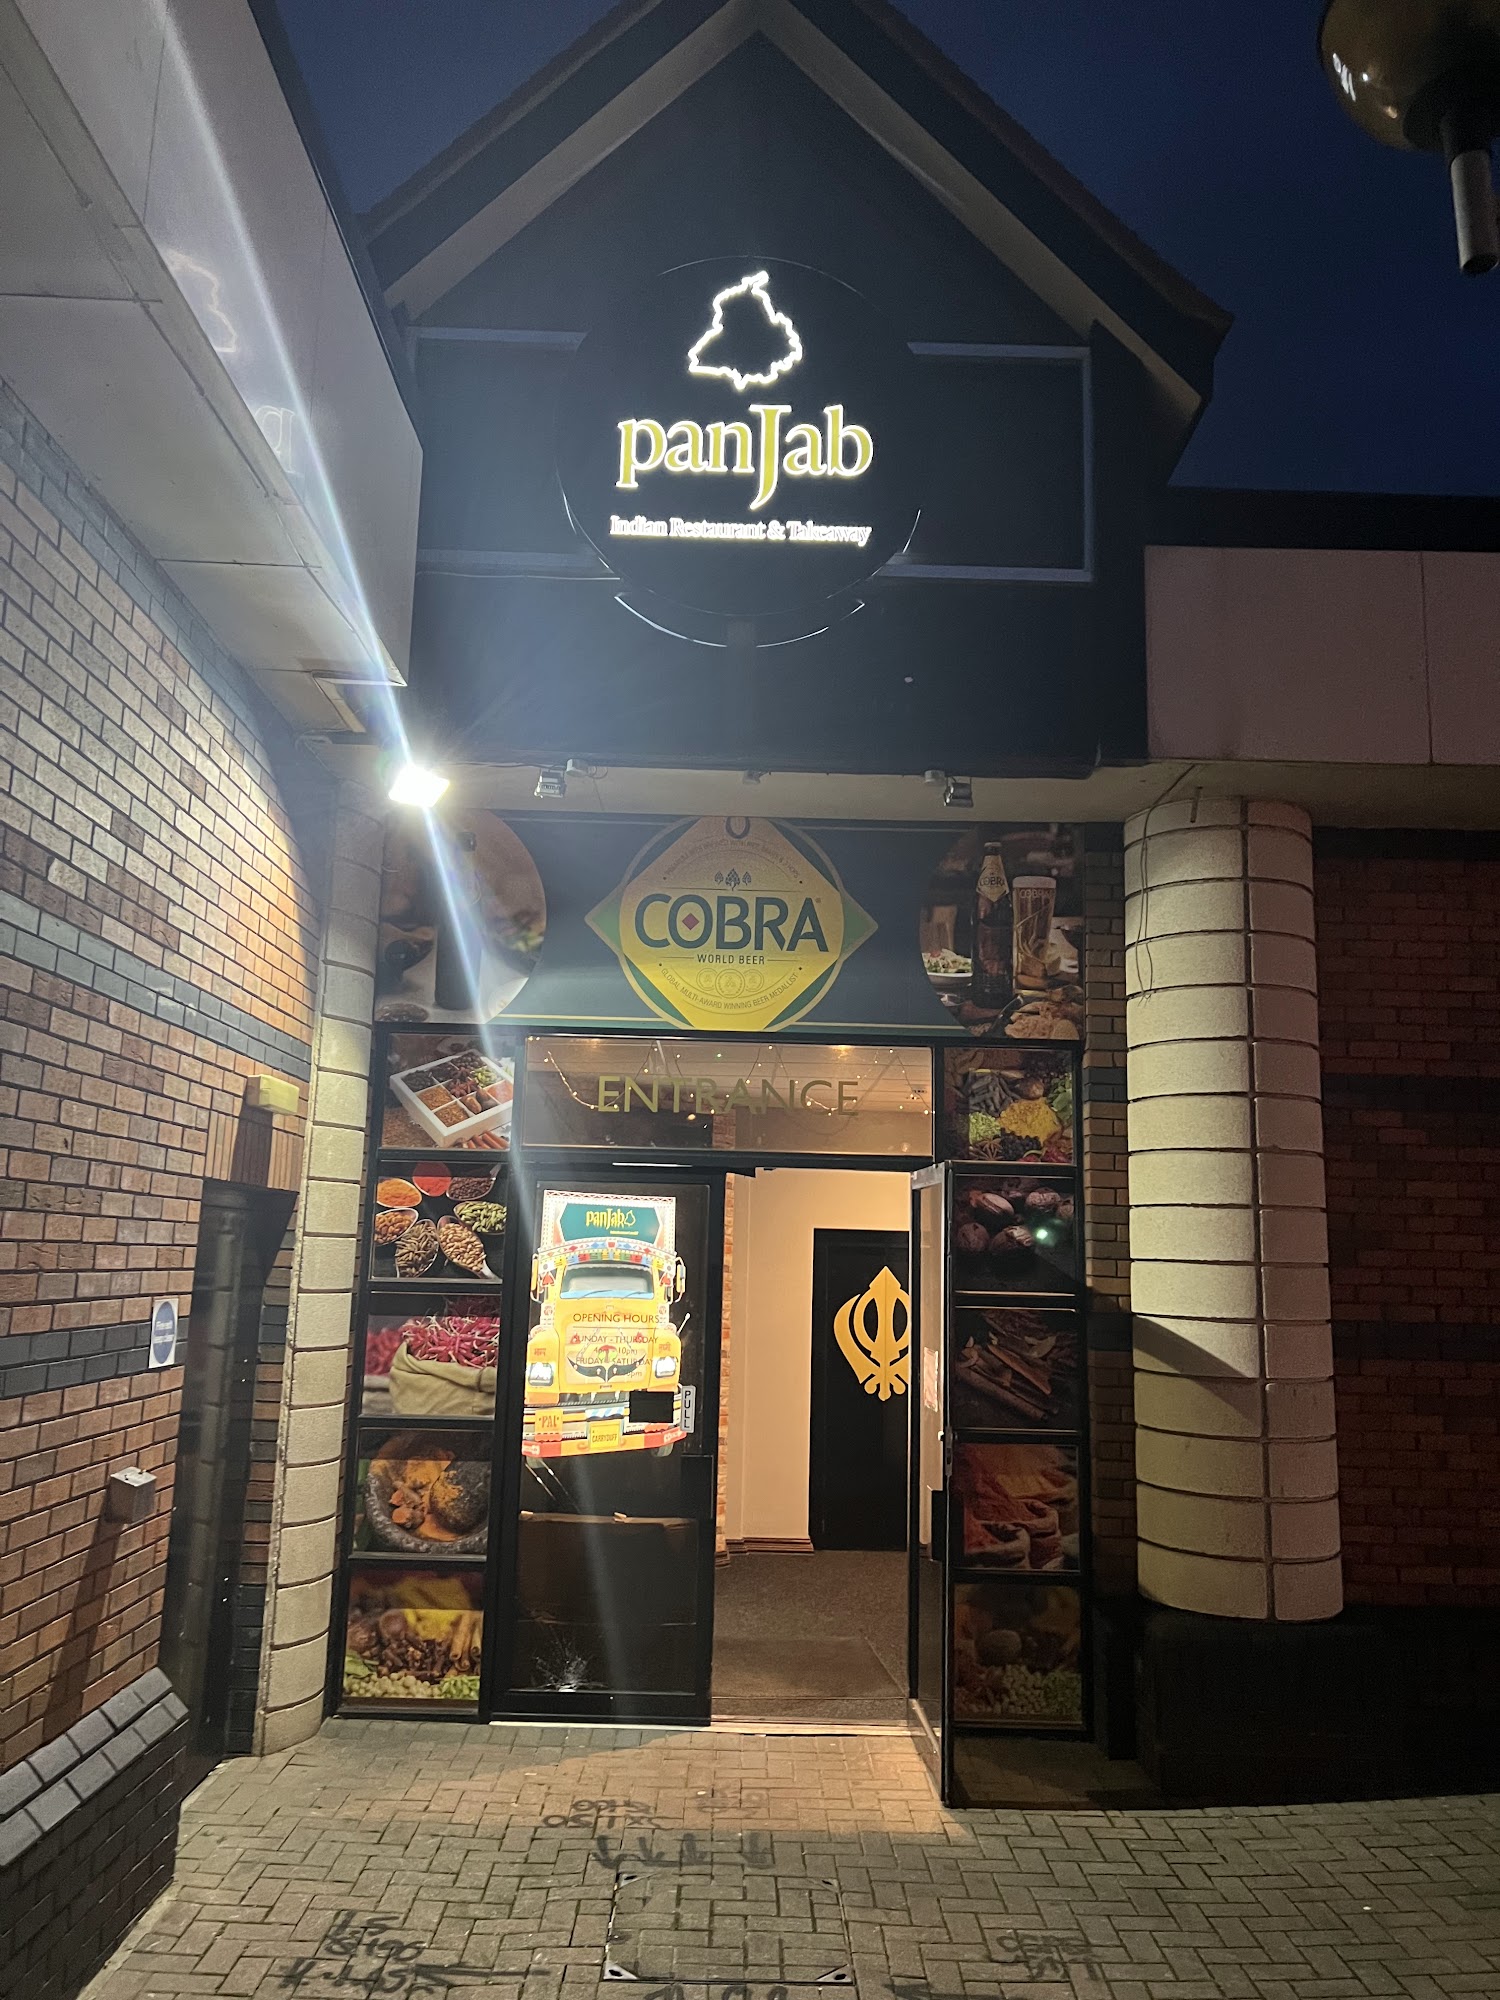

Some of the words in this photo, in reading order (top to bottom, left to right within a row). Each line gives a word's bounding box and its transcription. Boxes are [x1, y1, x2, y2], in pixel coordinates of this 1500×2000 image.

[616, 404, 874, 509] panJab
[610, 515, 667, 536] Indian
[669, 517, 766, 539] Restaurant
[767, 520, 785, 540] &
[786, 521, 872, 547] Takeaway
[634, 893, 829, 952] COBRA
[697, 954, 735, 964] WORLD
[739, 955, 765, 965] BEER
[661, 968, 681, 990] GLOBAL
[680, 987, 723, 1009] MULTI-AWARD
[723, 1001, 752, 1010] WINNING
[753, 995, 770, 1006] BEER
[768, 972, 799, 999] MEDALLIST
[597, 1075, 859, 1117] ENTRANCE
[573, 1313, 620, 1323] OPENING
[623, 1314, 660, 1324] HOURS
[574, 1335, 607, 1343] SUNDAY
[615, 1335, 658, 1344] THURSDAY
[576, 1357, 604, 1365] FRIDAY
[618, 1347, 638, 1356] 10pm
